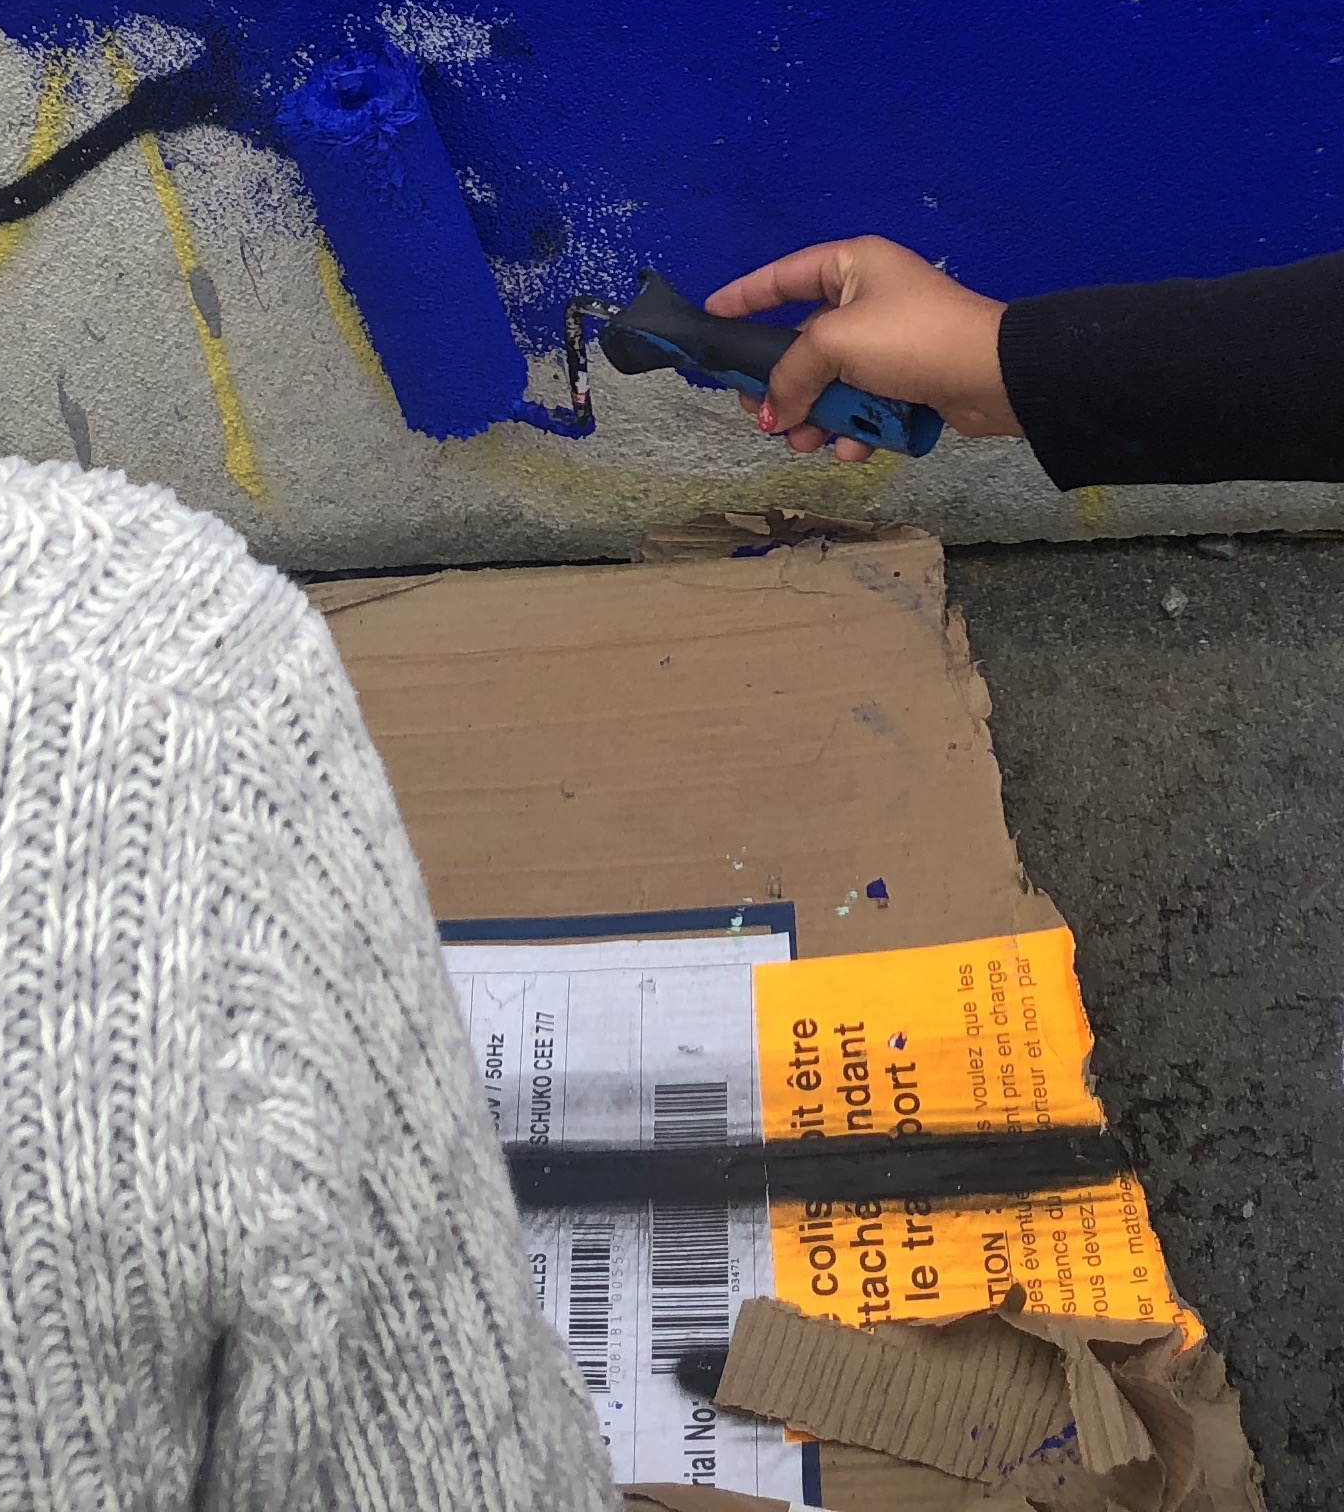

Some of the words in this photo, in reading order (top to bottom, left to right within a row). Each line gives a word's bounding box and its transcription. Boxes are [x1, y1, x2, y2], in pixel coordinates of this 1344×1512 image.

[957, 963, 974, 992] les
[1017, 956, 1037, 988] par
[988, 960, 1008, 1026] charge
[536, 1011, 554, 1034] 7/7
[963, 1001, 983, 1037] que
[1021, 995, 1039, 1032] non
[485, 1033, 504, 1080] 50Hz
[534, 1038, 553, 1070] CEE
[786, 1018, 822, 1091] être
[997, 1033, 1012, 1057] en
[1024, 1038, 1042, 1058] et
[834, 1021, 873, 1130] ndant
[967, 1047, 988, 1110] voulez
[997, 1063, 1022, 1098] pris
[529, 1075, 552, 1145] SCHUKO
[1045, 1195, 1064, 1220] du
[799, 1199, 838, 1296] colis
[1080, 1205, 1101, 1267] devez
[731, 1258, 740, 1292] D3471
[905, 1265, 939, 1301] le
[1052, 1230, 1077, 1316] surance
[1130, 1265, 1149, 1284] le
[1027, 1279, 1050, 1314] ges
[1090, 1275, 1109, 1319] ous
[684, 1450, 716, 1486] rial
